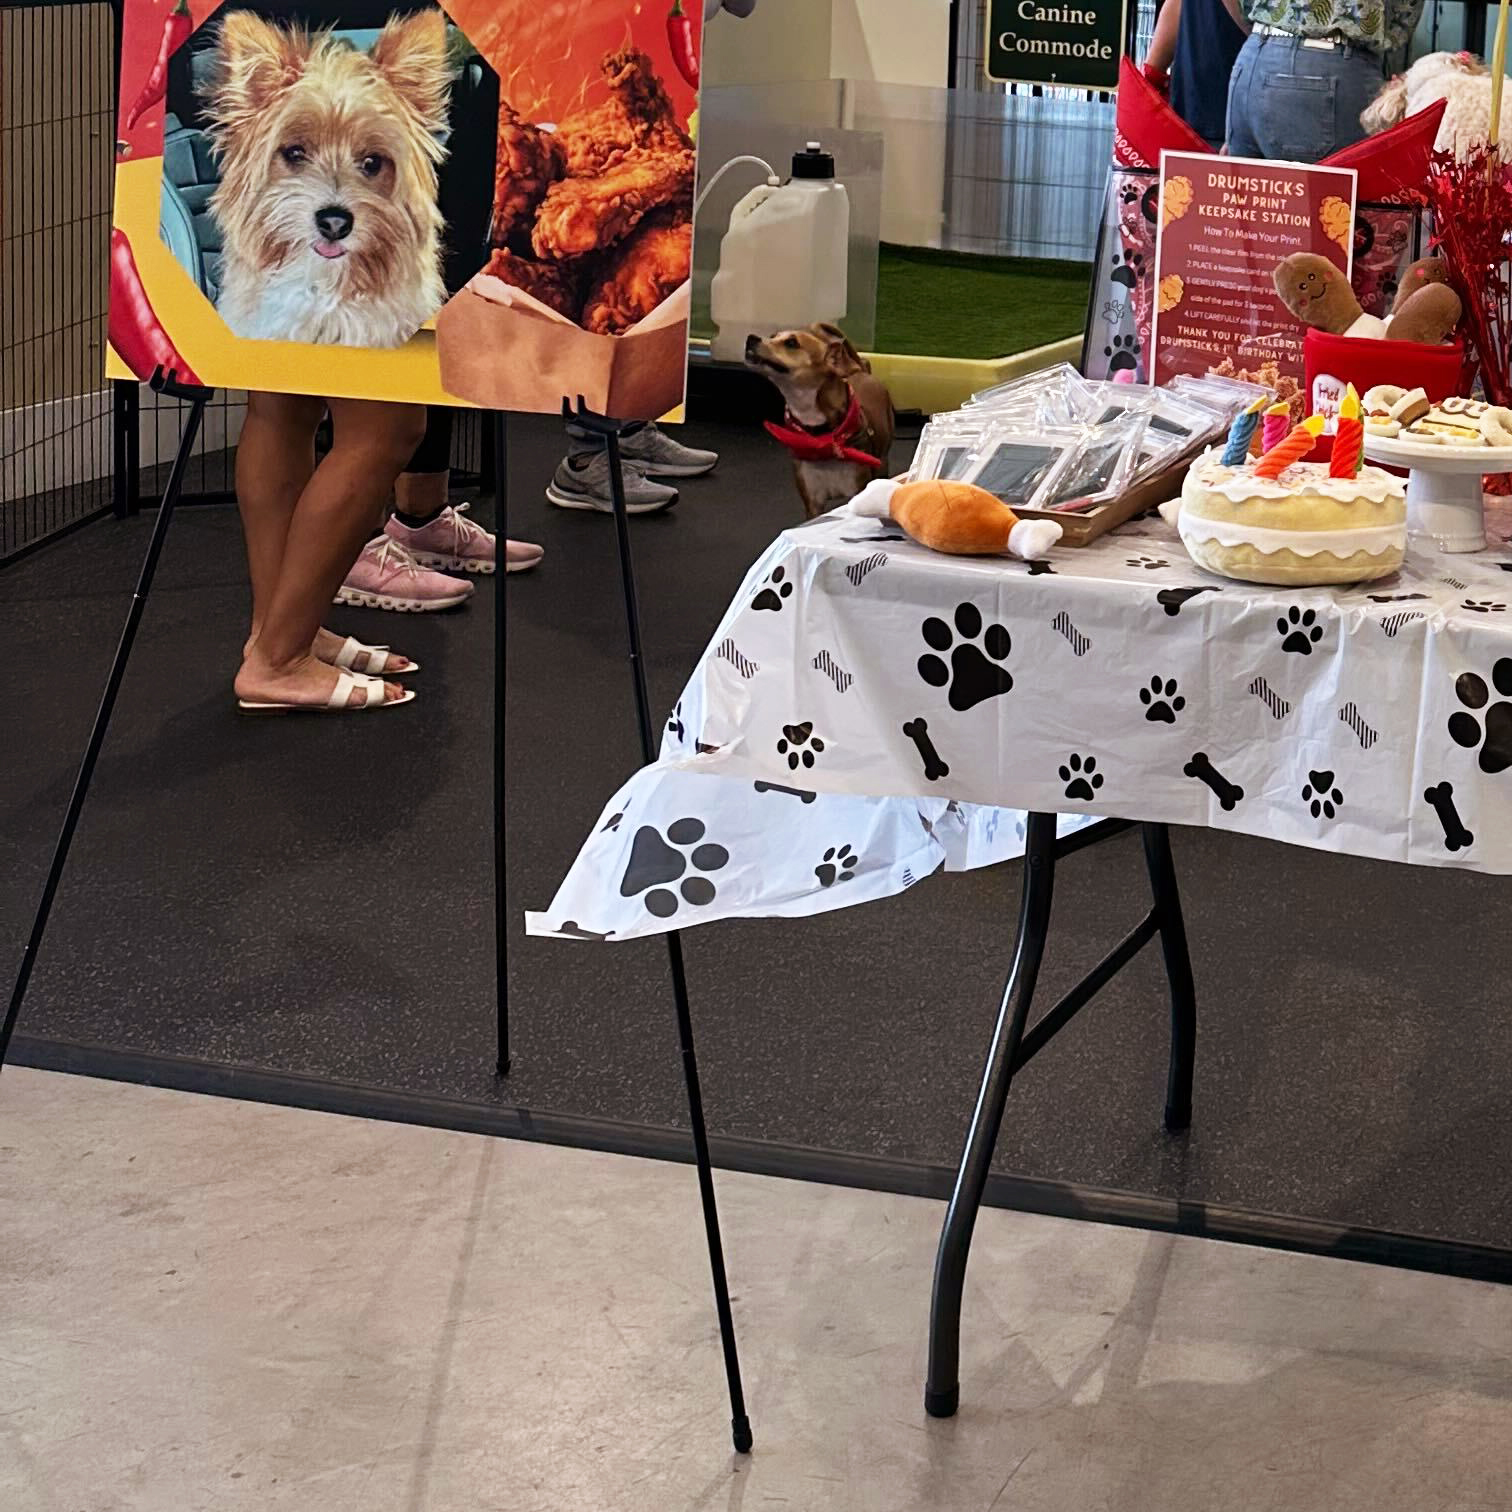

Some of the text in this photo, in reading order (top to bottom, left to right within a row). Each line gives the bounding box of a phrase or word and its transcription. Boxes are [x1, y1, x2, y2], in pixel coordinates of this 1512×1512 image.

[1017, 0, 1097, 26] Canine
[999, 31, 1113, 60] Commode
[1223, 193, 1287, 209] PAW PRINT
[1199, 205, 1311, 227] KEEPSAKE STATION
[1204, 226, 1222, 236] How
[1224, 227, 1234, 238] To
[1236, 230, 1257, 240] Make
[1259, 232, 1278, 242] Your
[1178, 325, 1208, 337] THANK
[1212, 329, 1231, 341] YOU
[1257, 336, 1304, 349] CELEBRAT
[1238, 346, 1283, 361] BIRTHDAY
[1287, 353, 1305, 363] WIT
